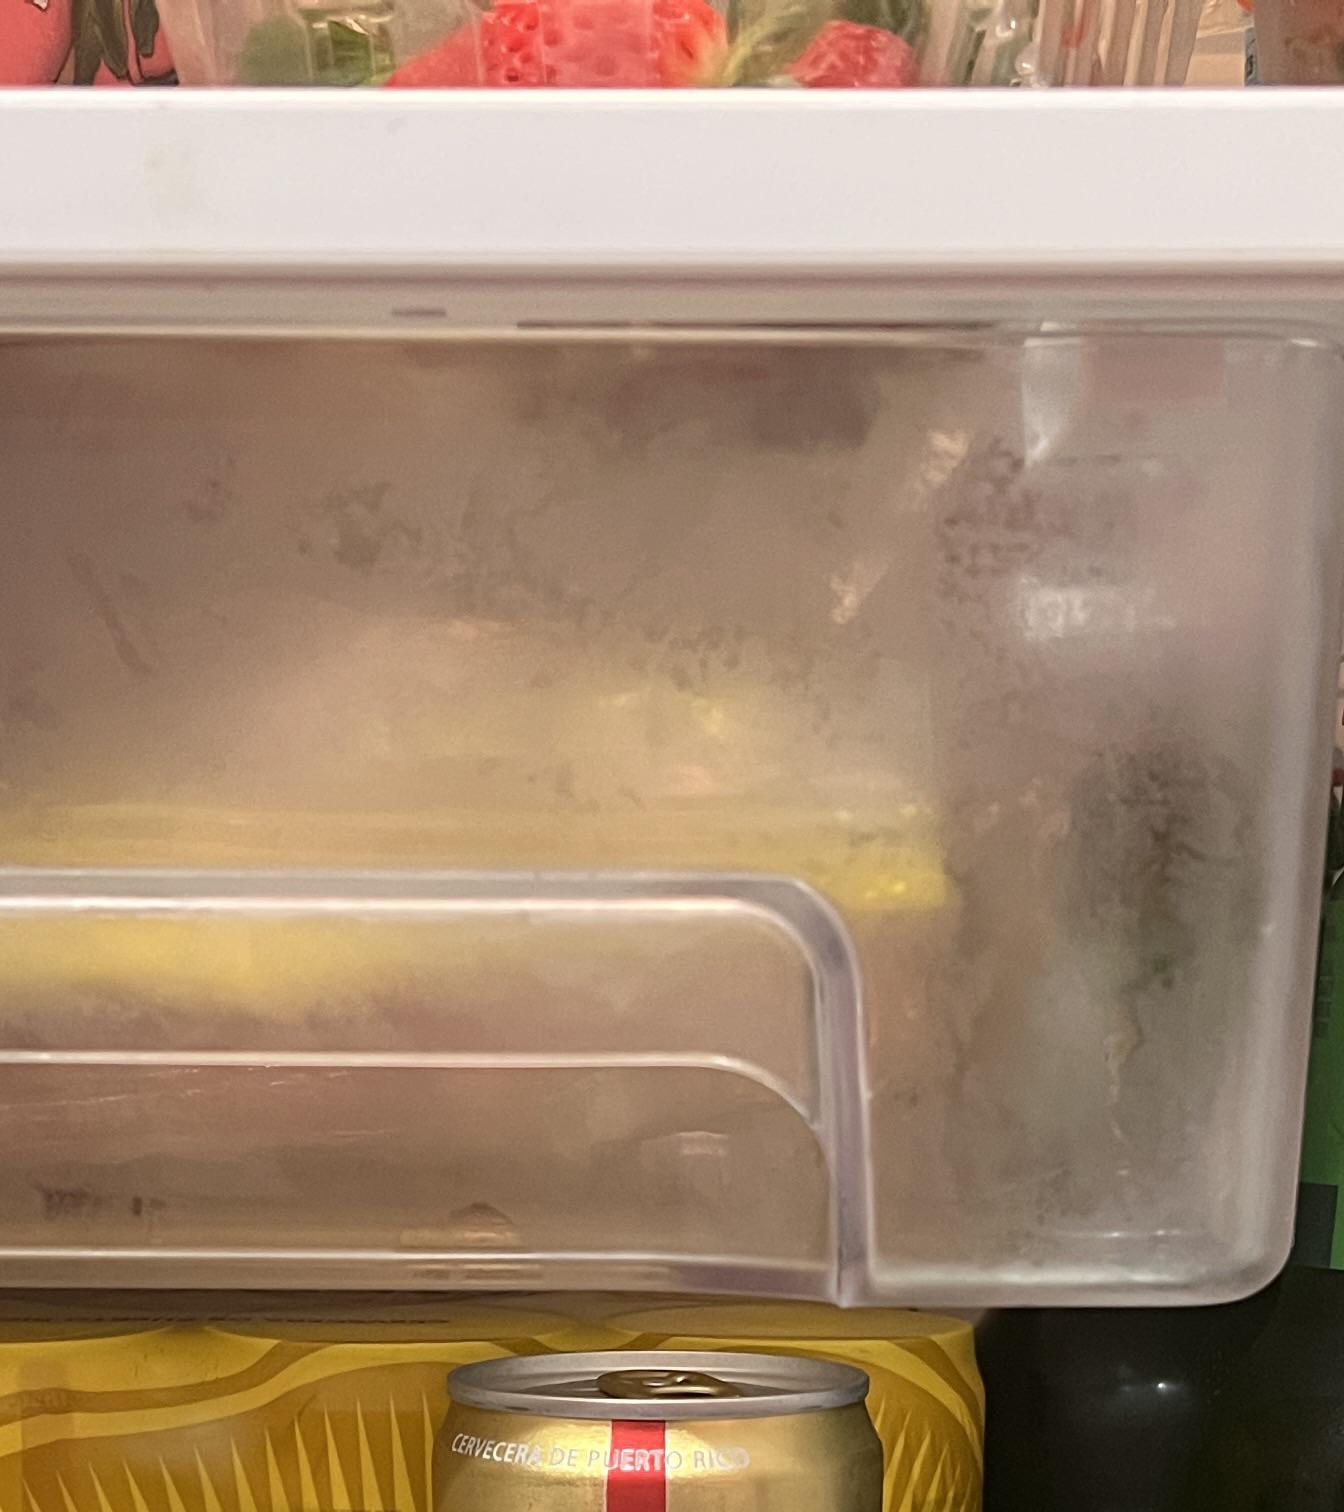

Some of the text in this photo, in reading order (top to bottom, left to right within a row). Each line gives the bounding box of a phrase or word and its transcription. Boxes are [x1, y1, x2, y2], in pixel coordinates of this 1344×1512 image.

[451, 1432, 752, 1472] CERVECERA DE PUERTO RICO
